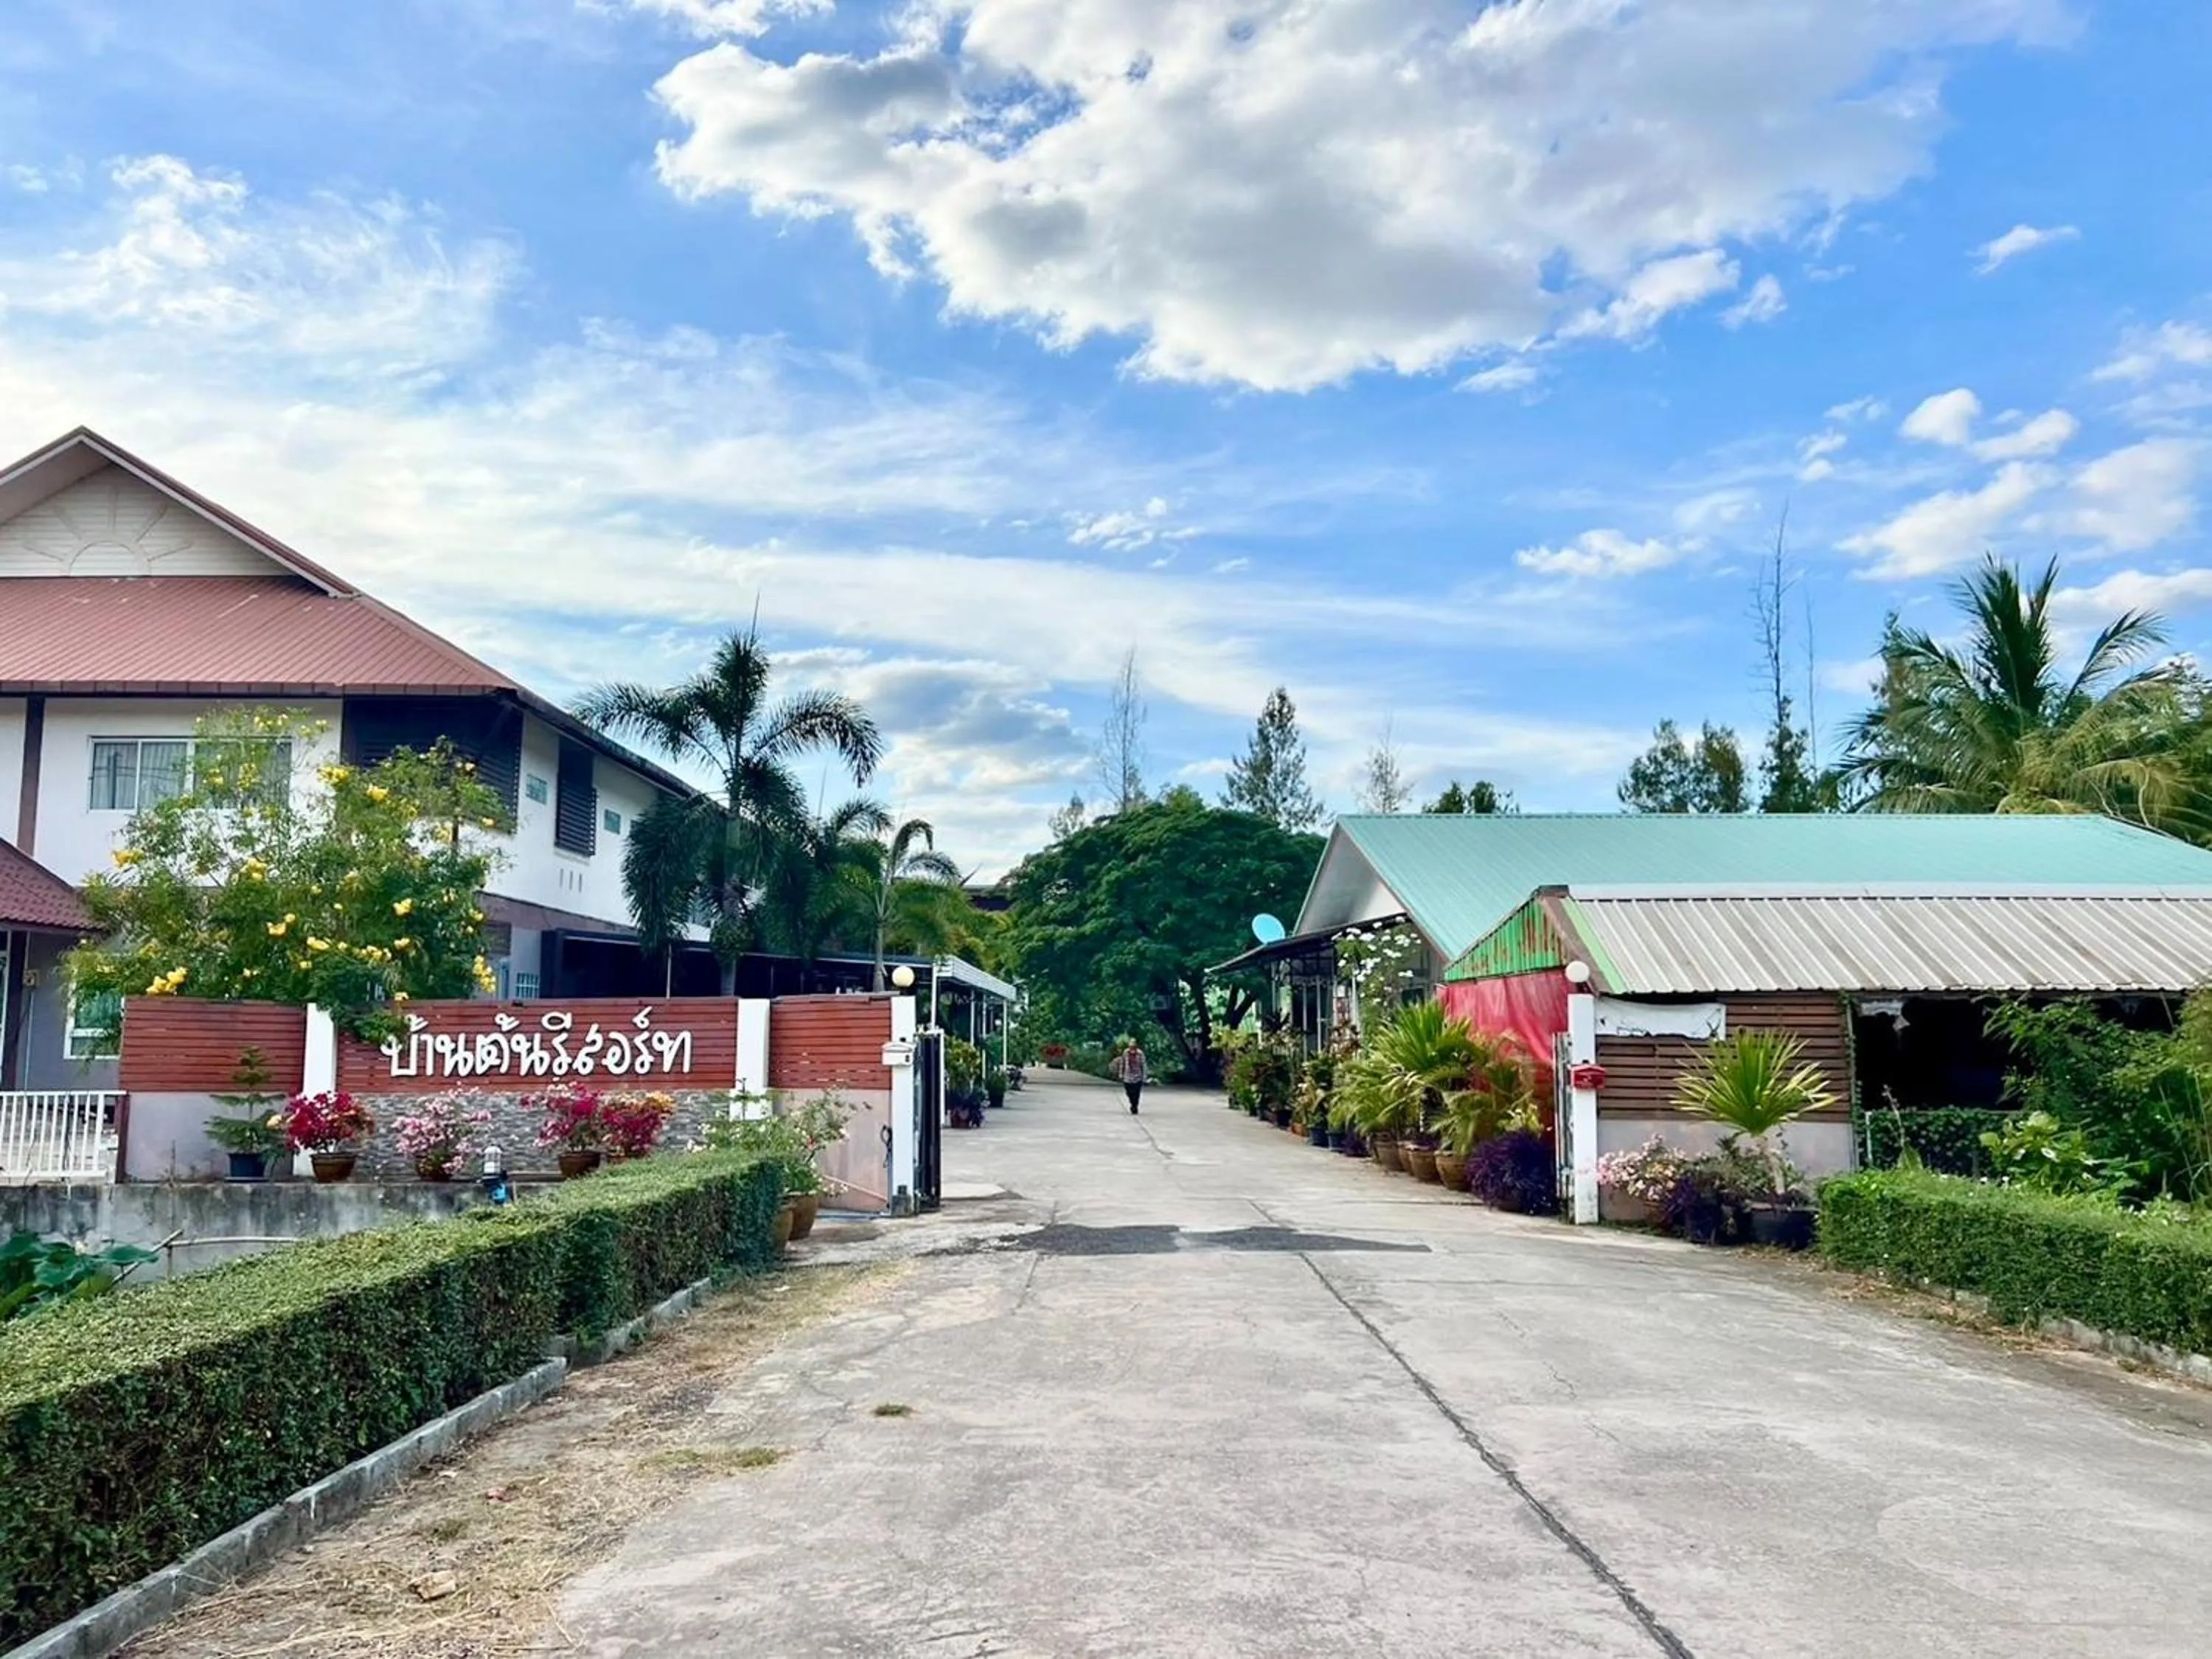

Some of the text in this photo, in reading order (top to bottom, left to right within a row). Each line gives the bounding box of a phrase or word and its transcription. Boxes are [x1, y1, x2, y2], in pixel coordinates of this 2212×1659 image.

[380, 1006, 692, 1077] บ้านต้นรีสอร์ท
